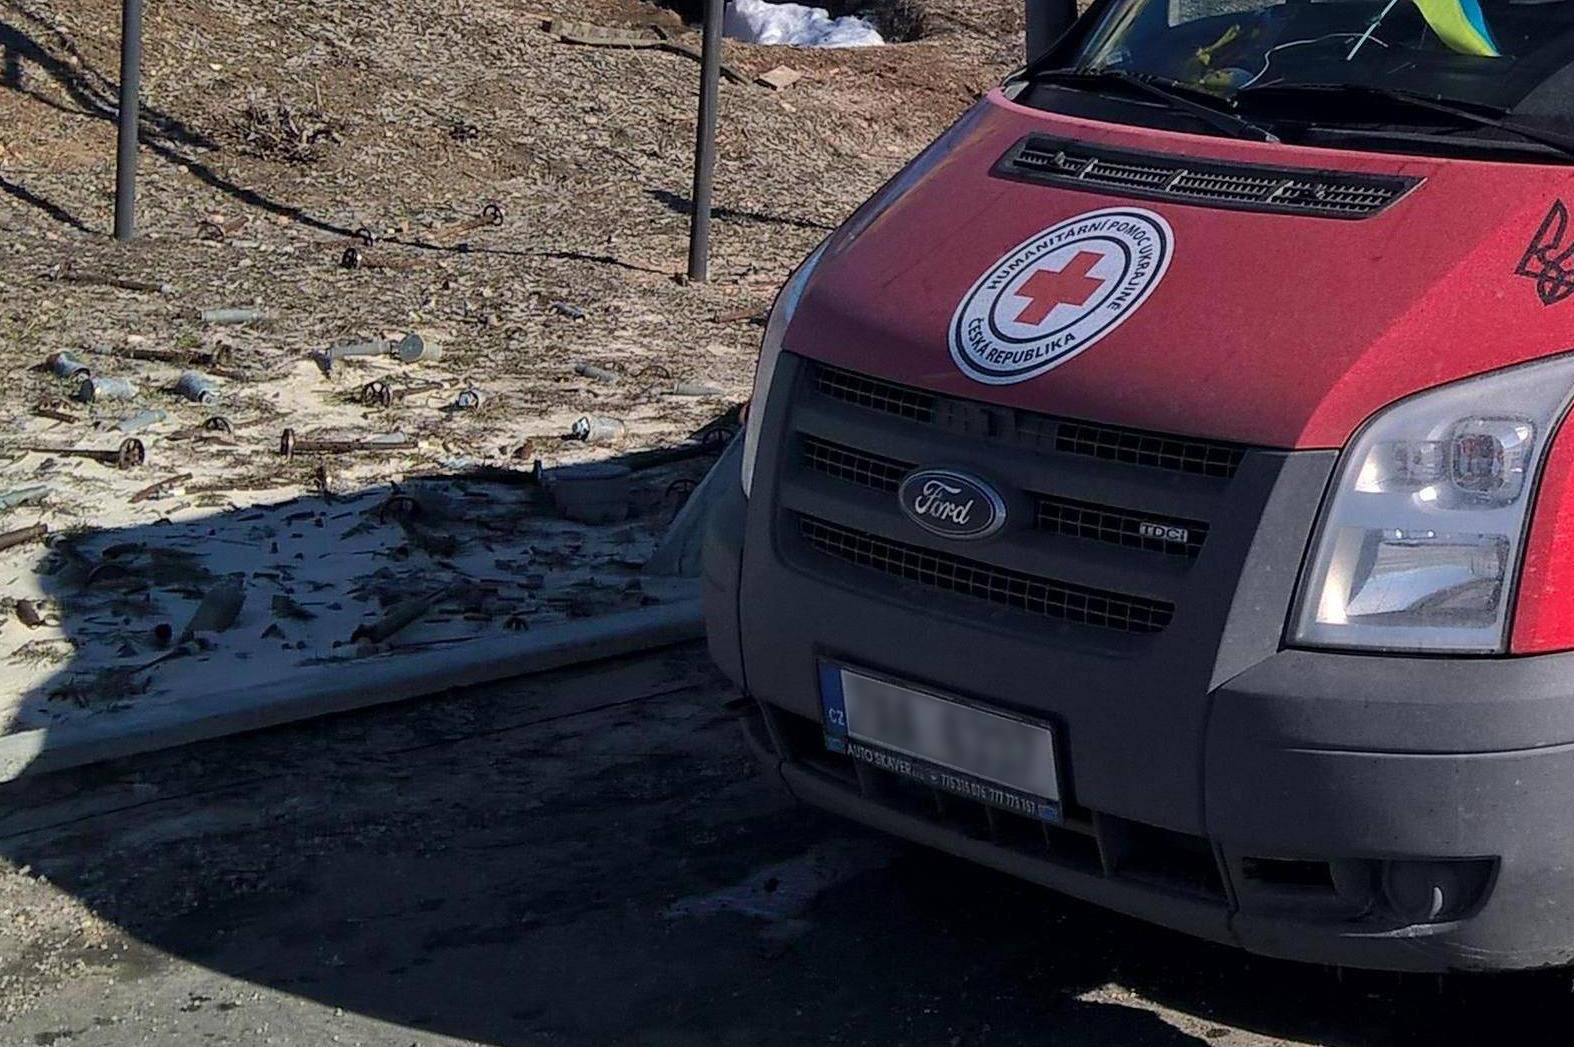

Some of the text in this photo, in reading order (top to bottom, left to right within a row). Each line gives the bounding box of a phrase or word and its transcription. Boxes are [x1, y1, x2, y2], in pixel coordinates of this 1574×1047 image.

[1106, 220, 1151, 246] POMOC
[967, 316, 1076, 364] ČESKÁ REPUBLIKA
[914, 479, 974, 526] Ford
[828, 707, 845, 727] CZ
